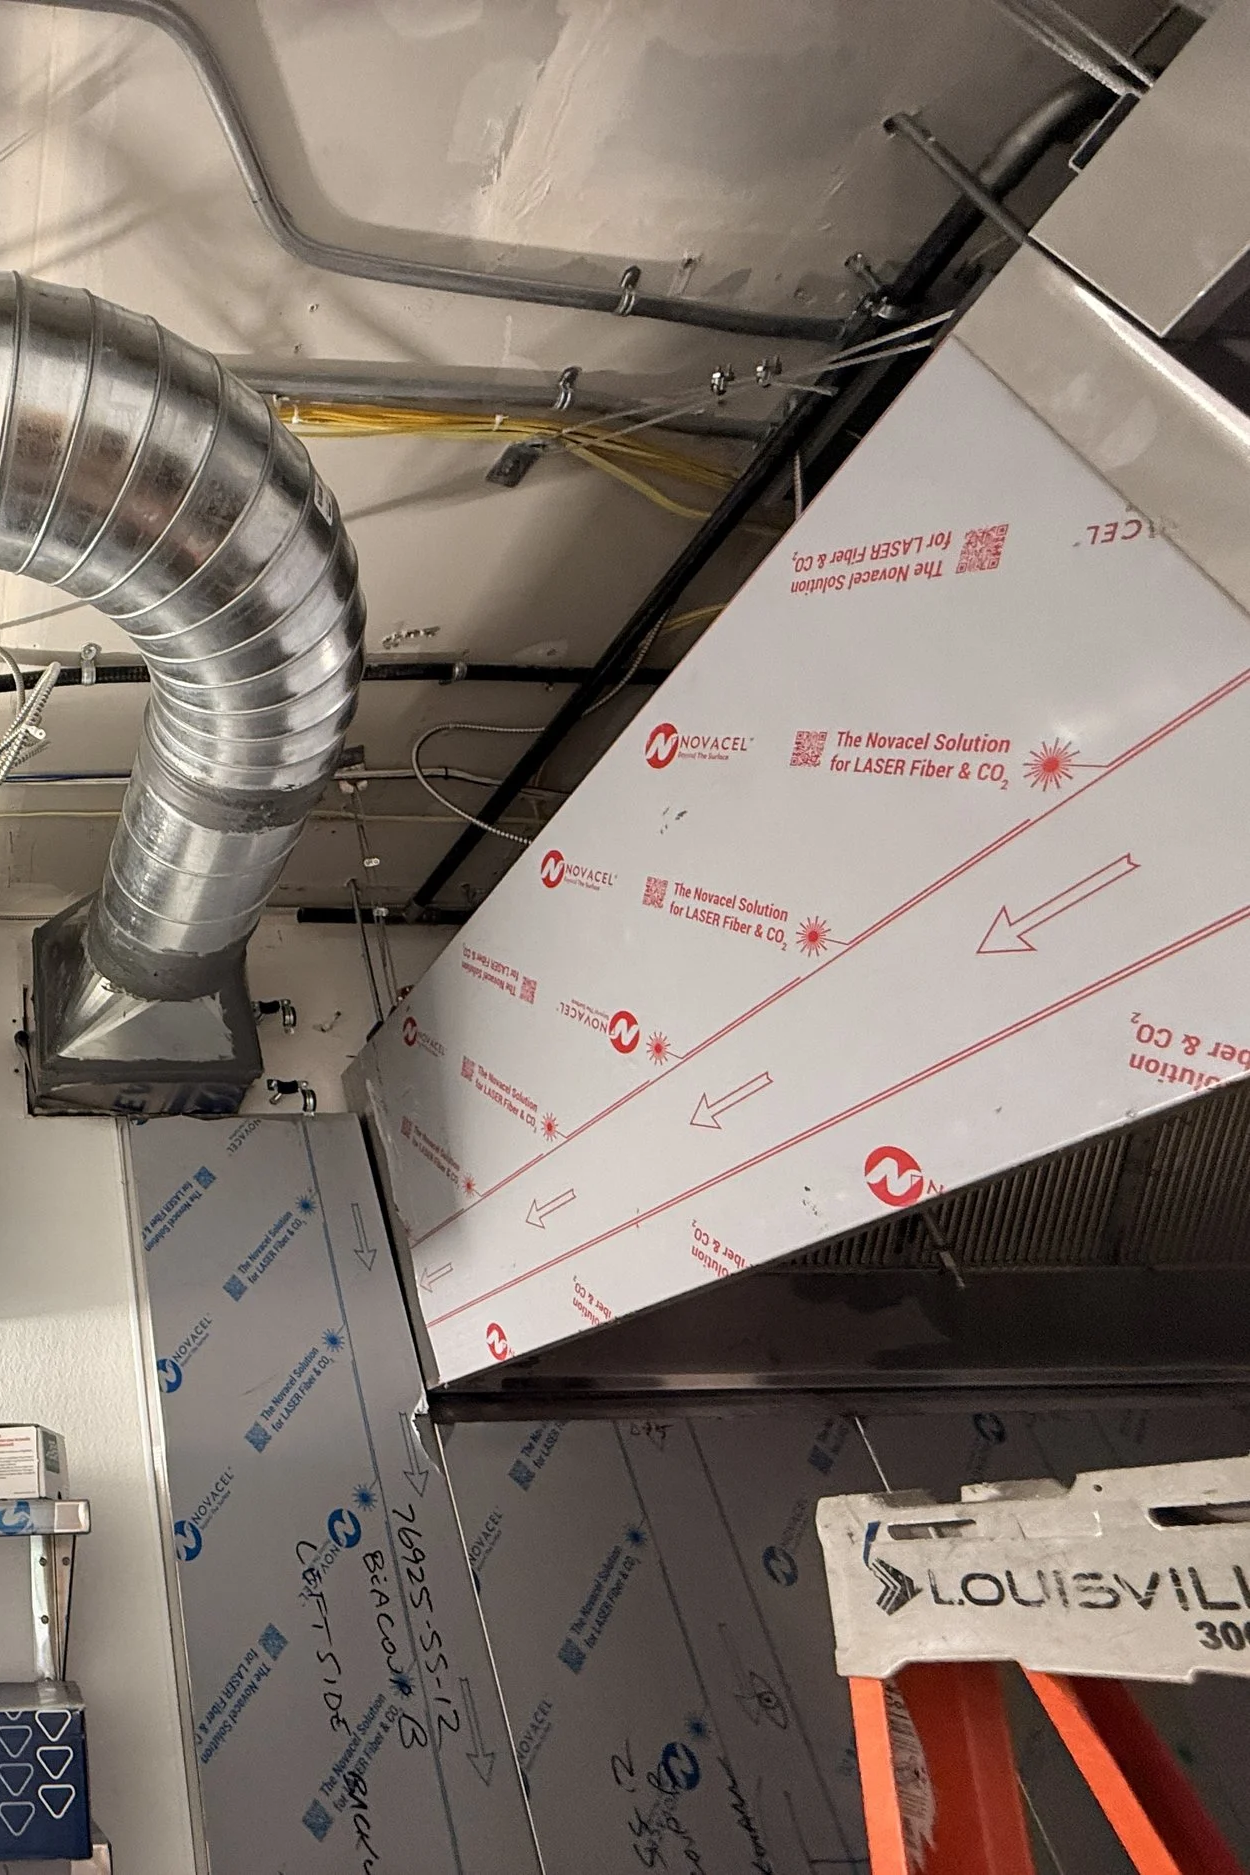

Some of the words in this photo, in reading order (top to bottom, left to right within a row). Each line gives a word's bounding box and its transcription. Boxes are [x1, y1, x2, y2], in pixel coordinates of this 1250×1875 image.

[870, 536, 923, 560] LASER
[926, 531, 952, 550] for
[817, 554, 827, 568] &
[829, 546, 867, 566] Fiber
[914, 560, 942, 577] The
[790, 575, 846, 596] Solution
[849, 564, 910, 590] Novacel
[679, 736, 748, 752] NOVACEL
[836, 731, 862, 748] The
[865, 732, 930, 751] Novacel
[933, 733, 1010, 753] Solution
[830, 754, 851, 772] for
[853, 756, 905, 776] LASER
[910, 760, 952, 778] Fiber
[958, 763, 971, 779] &
[565, 863, 614, 886] NOVACEL
[673, 882, 692, 898] The
[694, 887, 737, 909] Novacel
[738, 897, 789, 922] Solution
[669, 901, 684, 916] for
[685, 906, 720, 927] LASER
[722, 915, 753, 935] Fiber
[754, 924, 764, 938] &
[491, 960, 510, 977] LASER
[559, 1002, 608, 1034] NOVACEL
[1182, 1034, 1201, 1056] &
[1208, 1042, 1250, 1070] ber
[475, 1078, 484, 1092] for
[483, 1085, 503, 1105] LASER
[502, 1098, 519, 1116] Fiber
[519, 1109, 525, 1121] &
[477, 1064, 488, 1079] The
[488, 1072, 512, 1096] Novacel
[511, 1088, 538, 1113] Solution
[713, 1239, 721, 1252] &
[724, 1246, 746, 1268] iber
[256, 1249, 277, 1274] LASER
[691, 1246, 730, 1278] olution
[588, 1292, 594, 1304] &
[596, 1300, 612, 1319] iber
[572, 1297, 600, 1326] olution
[171, 1316, 213, 1362] NOVACEL
[260, 1405, 276, 1421] The
[271, 1374, 297, 1407] Novacel
[293, 1347, 319, 1378] Solution
[271, 1418, 284, 1433] for
[280, 1392, 303, 1420] LASER
[298, 1375, 317, 1396] Fiber
[312, 1367, 321, 1376] &
[190, 1471, 235, 1525] NOVACEL
[1195, 1620, 1250, 1651] 30
[243, 1648, 259, 1665] for
[223, 1663, 249, 1699] LASER
[254, 1662, 272, 1682] The
[228, 1680, 259, 1724] Novacel
[317, 1650, 352, 1736] SIDE
[206, 1695, 227, 1725] Fiber
[199, 1722, 209, 1734] &
[200, 1719, 233, 1764] Solution
[320, 1775, 337, 1796] The
[332, 1731, 362, 1777] Novacel
[357, 1693, 386, 1735] Solution
